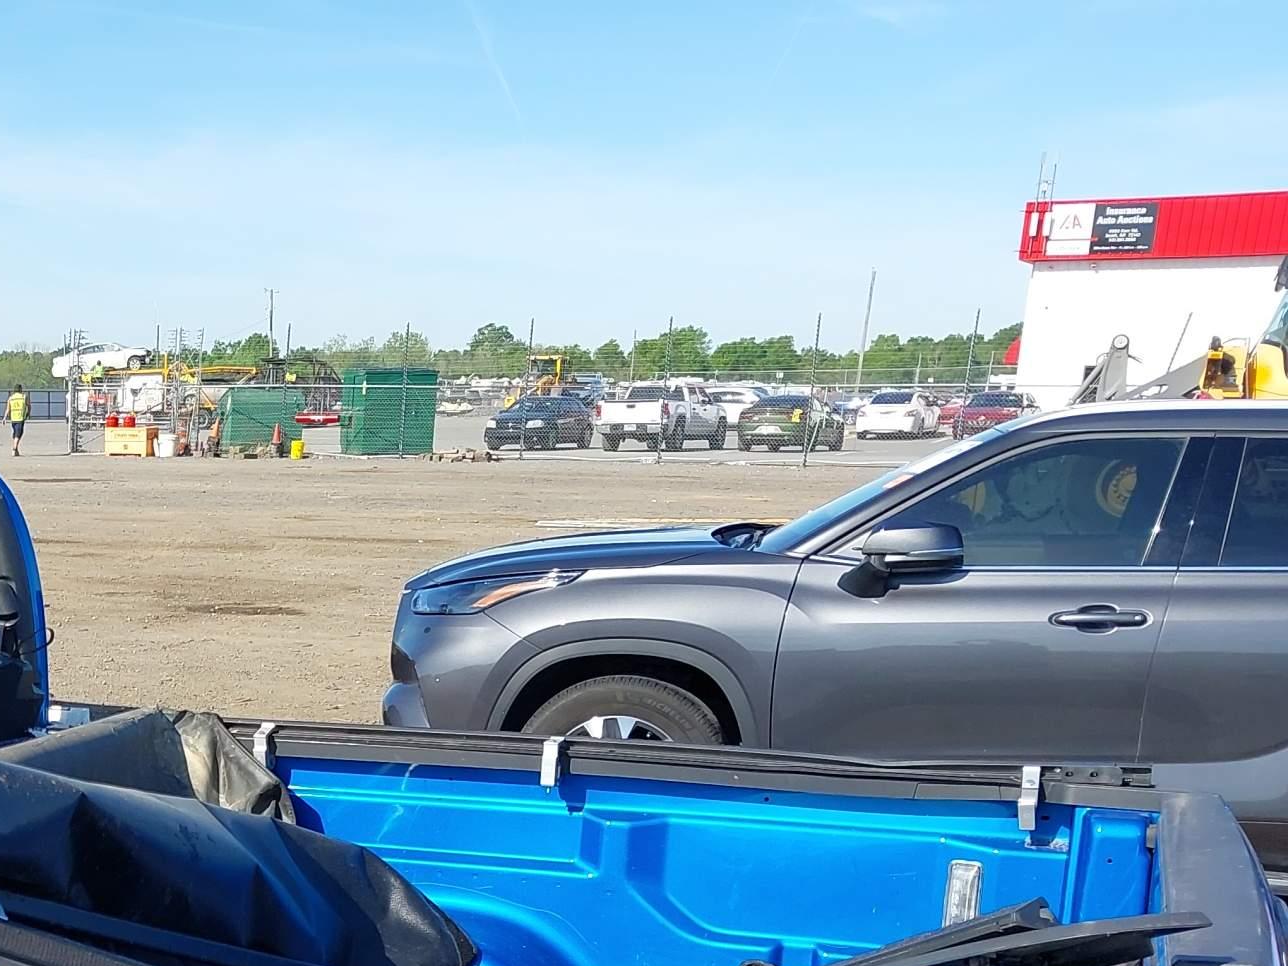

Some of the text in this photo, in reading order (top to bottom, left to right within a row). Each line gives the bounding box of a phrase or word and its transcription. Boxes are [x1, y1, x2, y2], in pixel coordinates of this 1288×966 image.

[1105, 207, 1147, 215] Insurance
[1096, 215, 1154, 225] Auto Auctions
